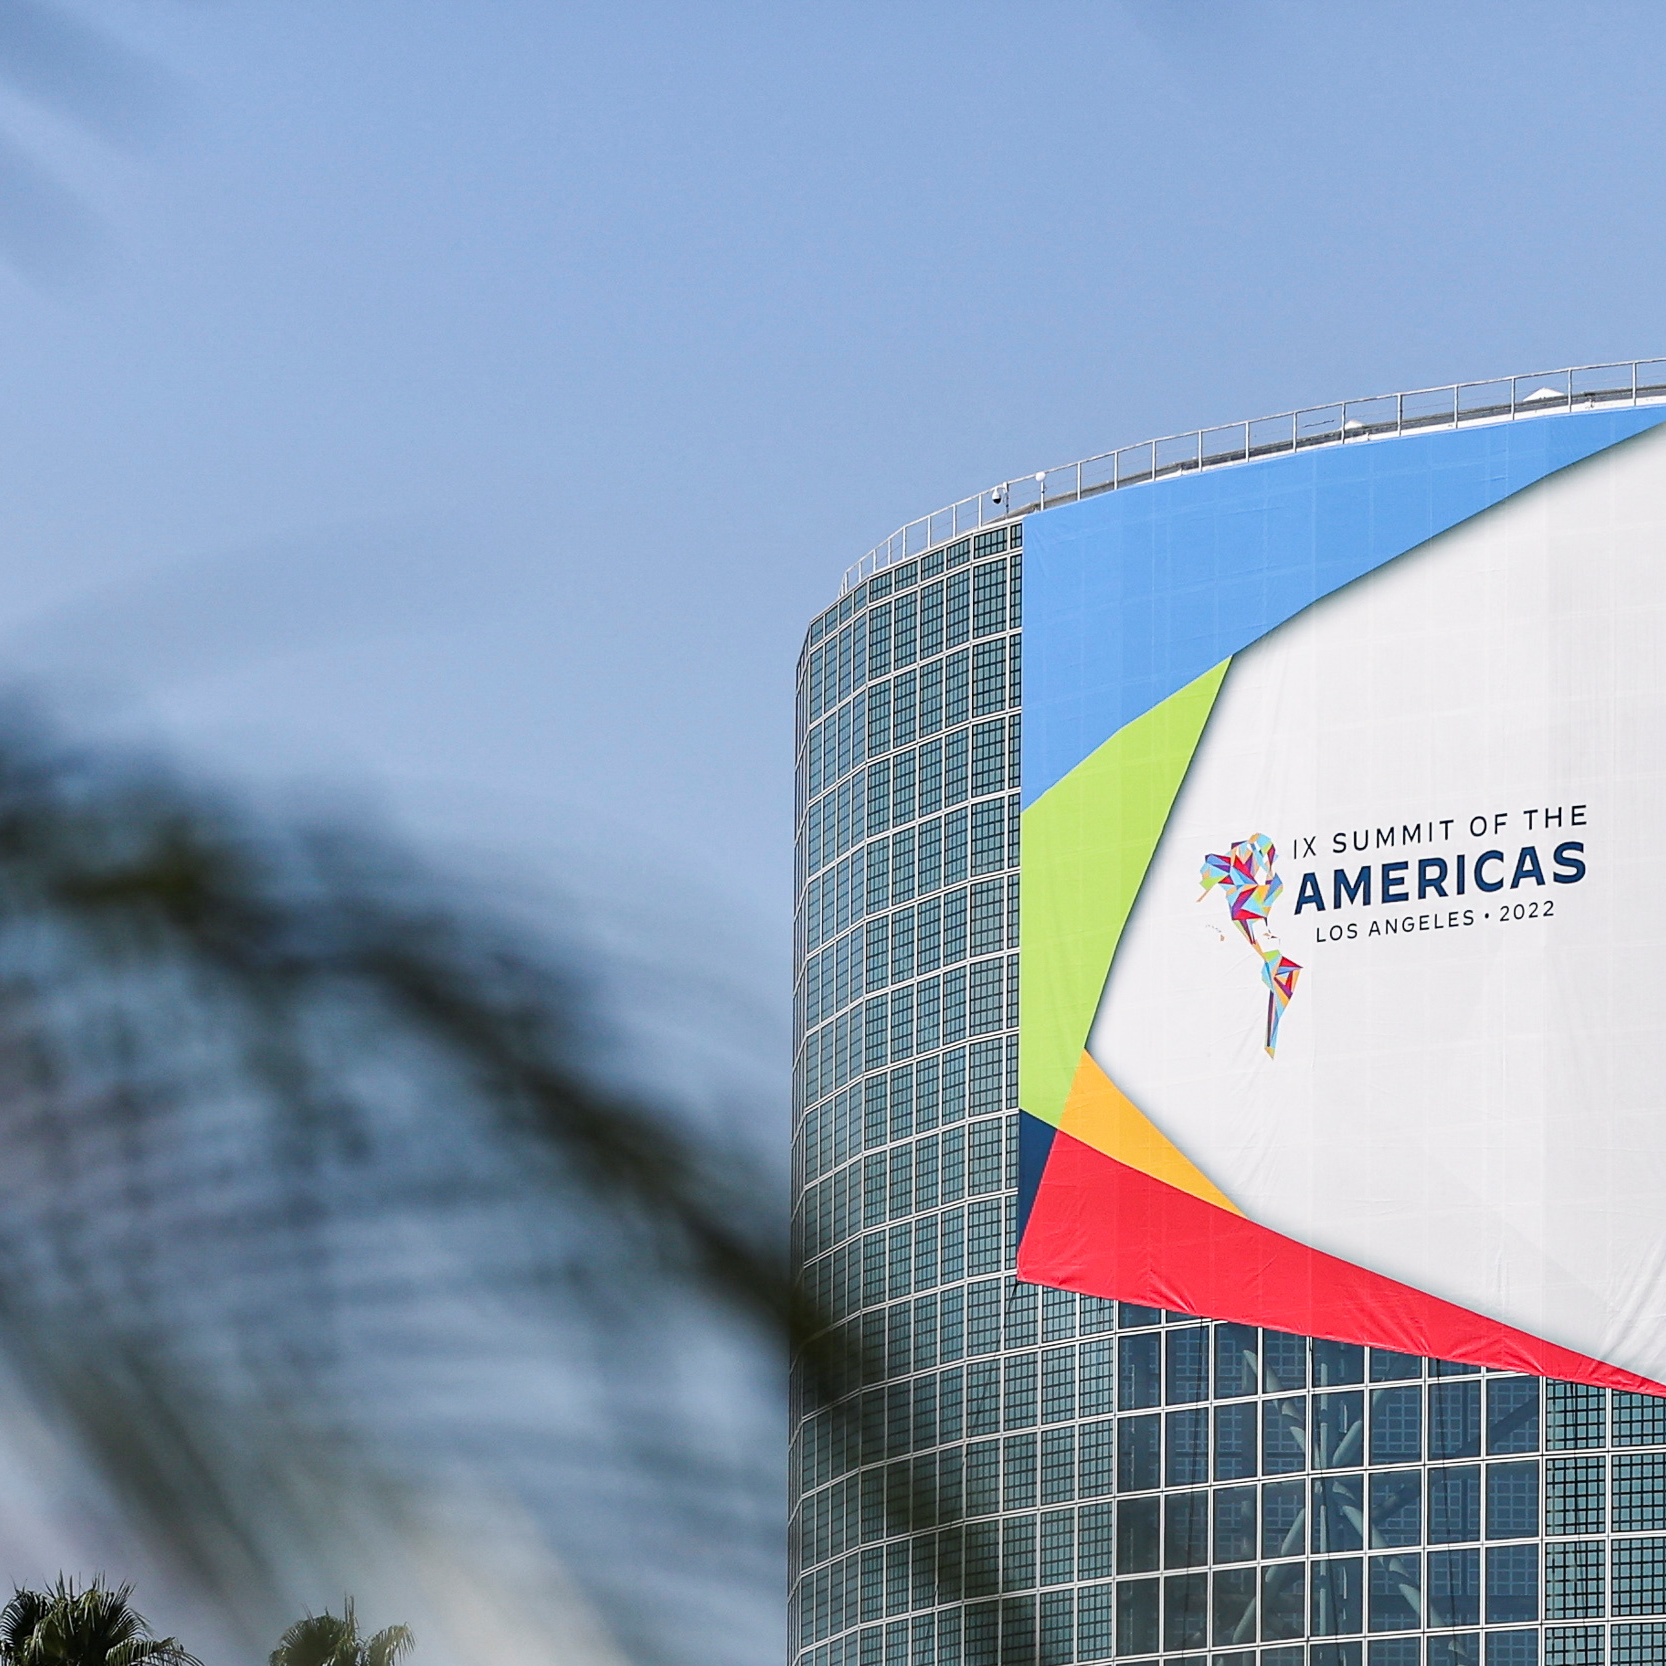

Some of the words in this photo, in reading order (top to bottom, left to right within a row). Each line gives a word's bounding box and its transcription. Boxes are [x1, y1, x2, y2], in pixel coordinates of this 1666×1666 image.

[1293, 835, 1317, 860] IX
[1332, 819, 1455, 854] SUMMIT
[1469, 812, 1508, 838] OF
[1523, 804, 1587, 831] THE
[1293, 840, 1586, 916] AMERICAS
[1316, 922, 1358, 943] LOS
[1368, 909, 1474, 937] ANGELES
[1499, 900, 1554, 922] 2022
